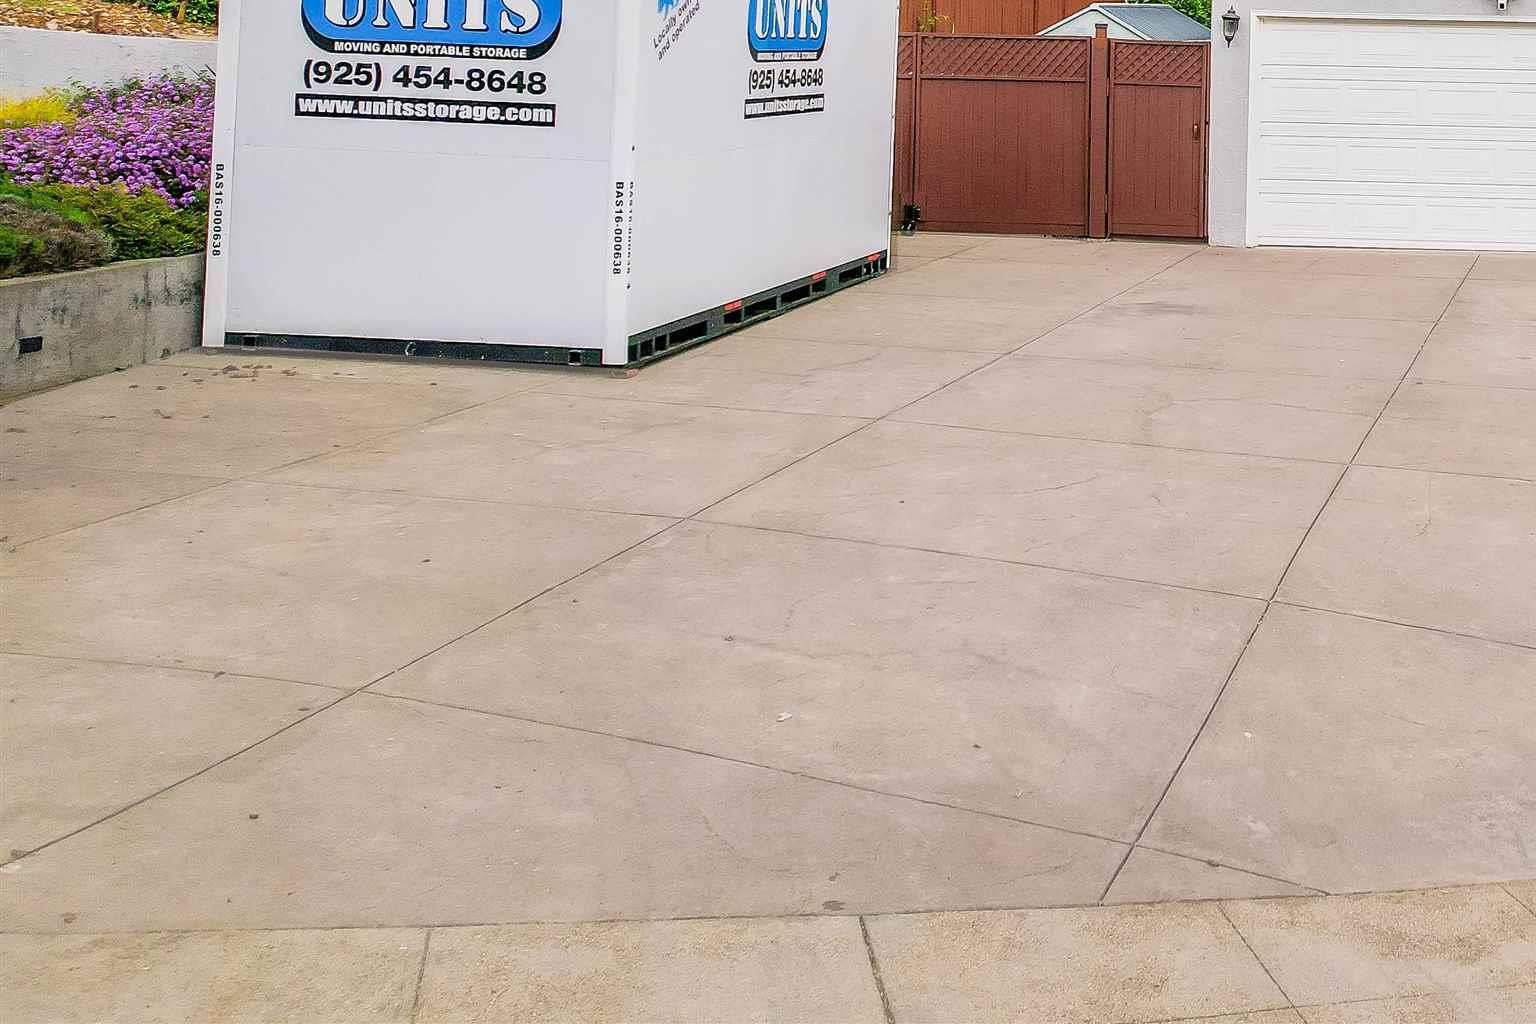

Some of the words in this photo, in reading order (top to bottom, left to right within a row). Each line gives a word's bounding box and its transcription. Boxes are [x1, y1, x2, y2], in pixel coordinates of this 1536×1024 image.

[653, 15, 677, 48] Locally
[658, 37, 671, 61] and
[671, 0, 700, 42] operated
[334, 41, 380, 53] MOVING
[383, 44, 407, 54] AND
[410, 45, 470, 57] PORTABLE
[473, 47, 528, 58] STORAGE
[304, 60, 382, 91] (925)
[392, 65, 547, 95] 454-8648
[749, 69, 775, 94] (925)
[778, 68, 823, 88] 454-8648
[298, 98, 553, 123] www.unitsstorage.com
[212, 163, 225, 257] BAS16-000638
[612, 181, 625, 275] BAS16-000638
